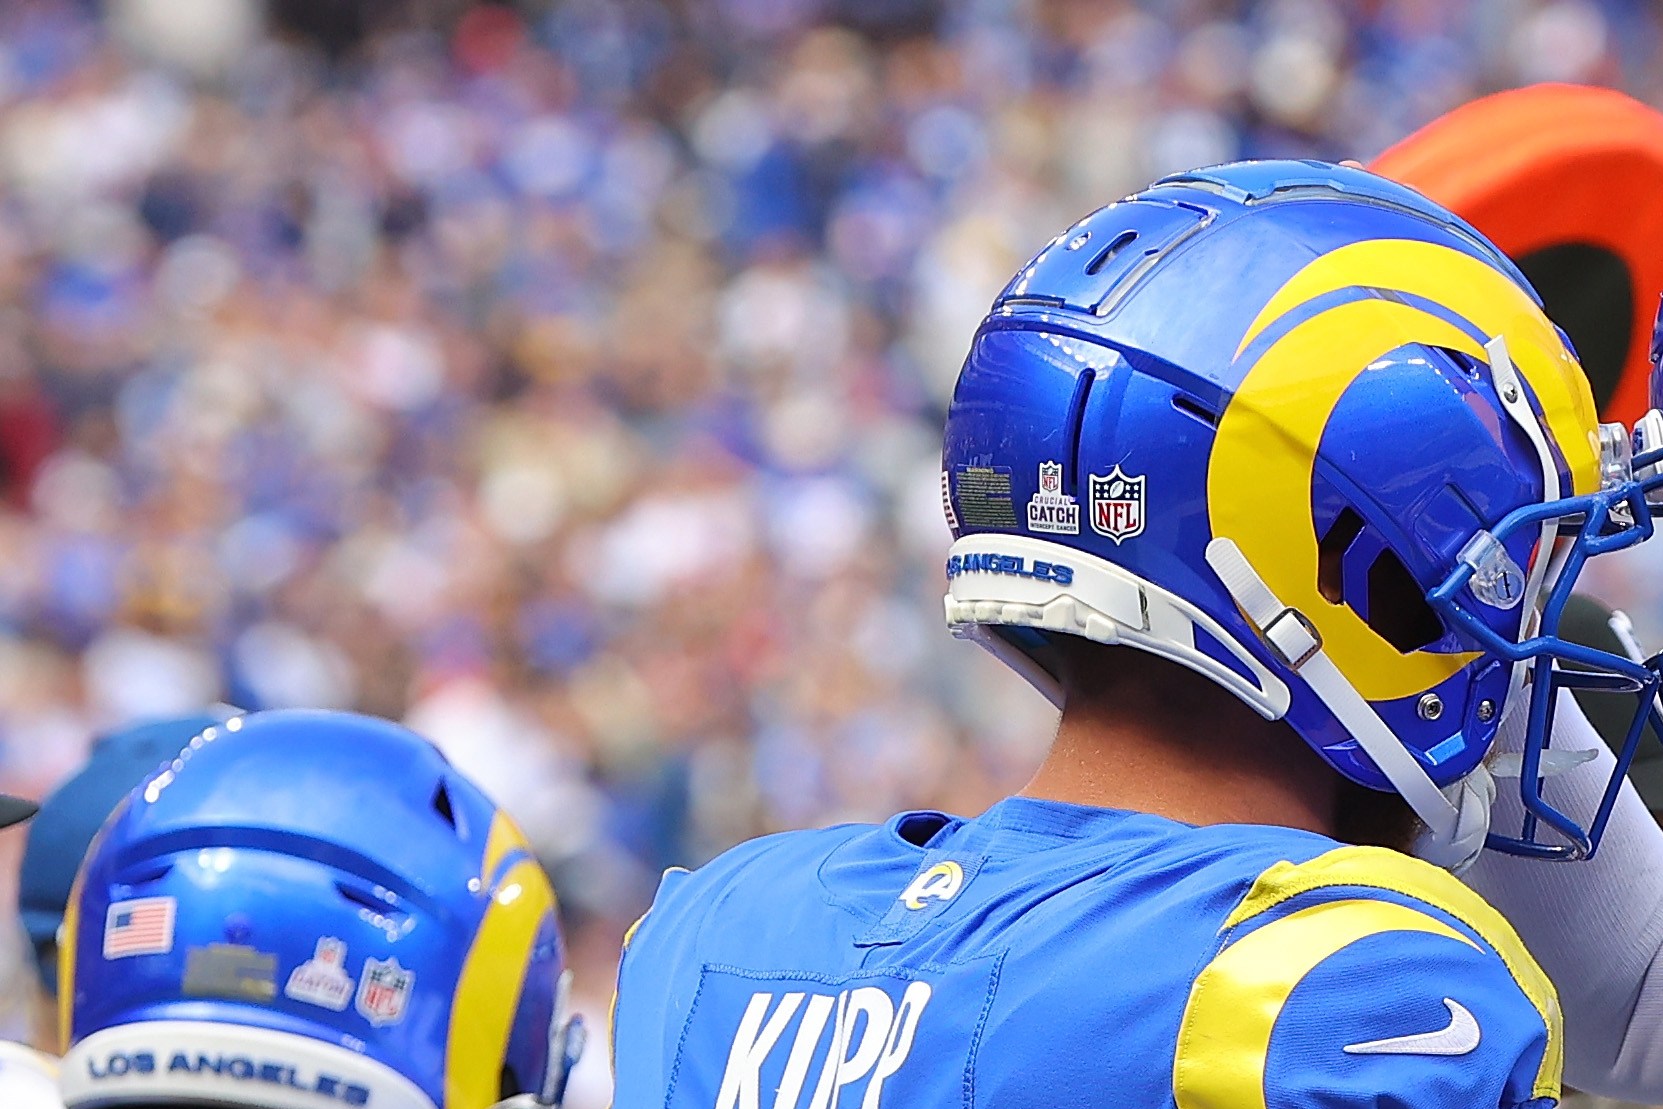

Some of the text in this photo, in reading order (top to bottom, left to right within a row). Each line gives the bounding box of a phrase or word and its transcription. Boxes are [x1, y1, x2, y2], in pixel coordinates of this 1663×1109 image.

[1043, 475, 1058, 490] NFL
[1034, 495, 1069, 506] CRUCIAL
[1029, 504, 1076, 525] CATCH
[1097, 502, 1137, 532] NFL
[962, 553, 1075, 585] ANGELES
[88, 1052, 371, 1107] LOS ANGELES
